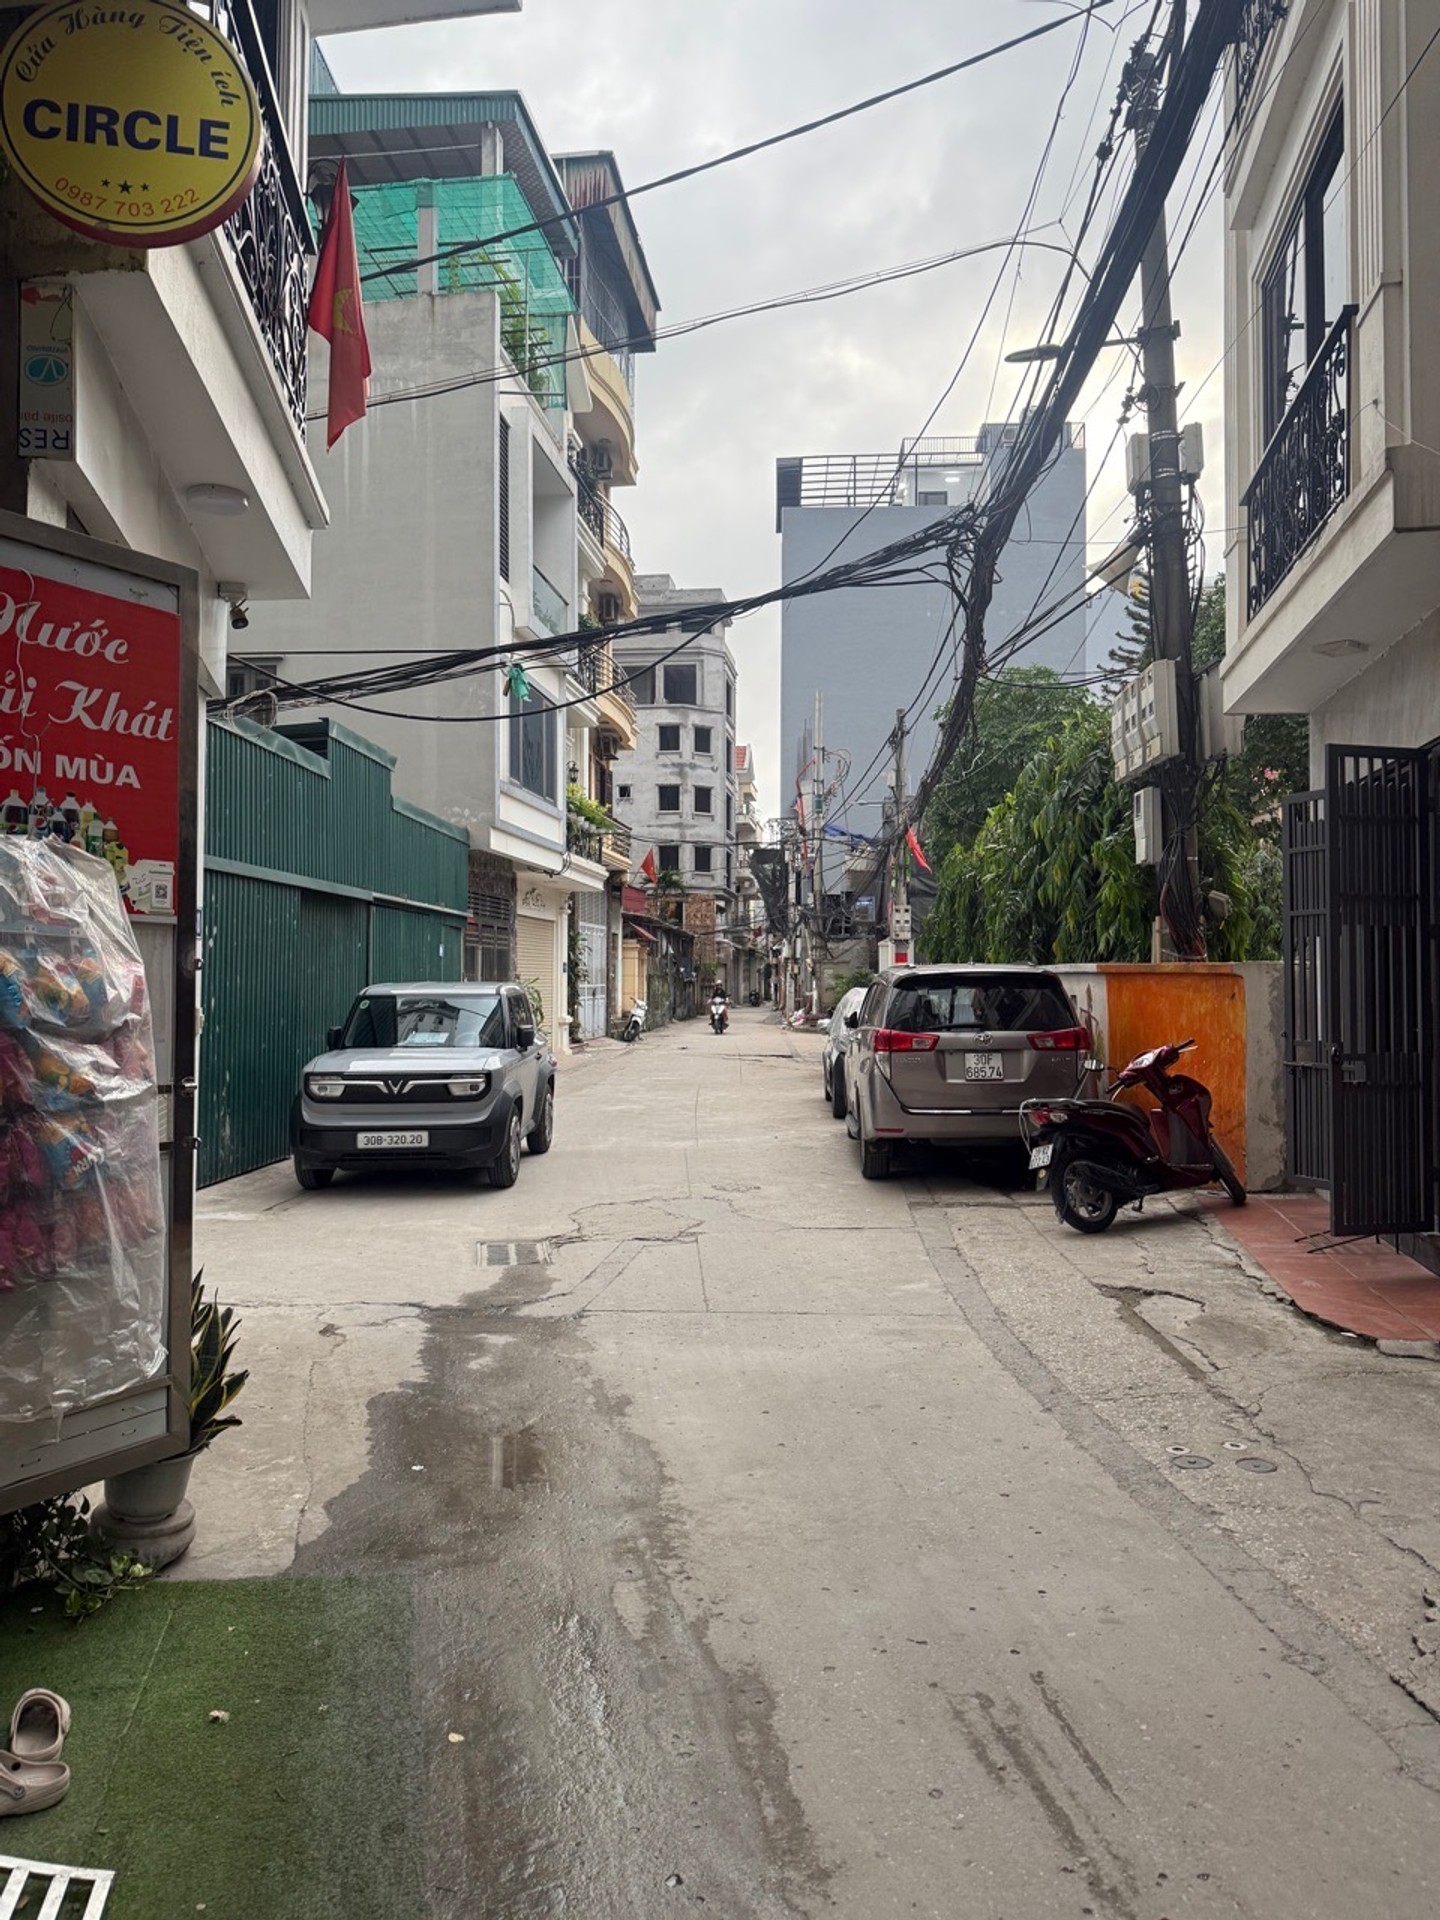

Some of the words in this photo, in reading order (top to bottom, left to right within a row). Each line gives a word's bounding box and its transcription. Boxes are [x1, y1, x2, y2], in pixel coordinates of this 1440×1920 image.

[15, 35, 57, 83] Cửa
[58, 6, 148, 36] Hàng
[158, 14, 214, 66] Tiện
[23, 98, 231, 160] CIRCLE
[54, 176, 109, 211] 0987
[115, 200, 155, 217] 703
[161, 188, 201, 215] 222
[18, 428, 70, 450] RES
[48, 680, 174, 741] Khát
[55, 753, 141, 789] MÙA
